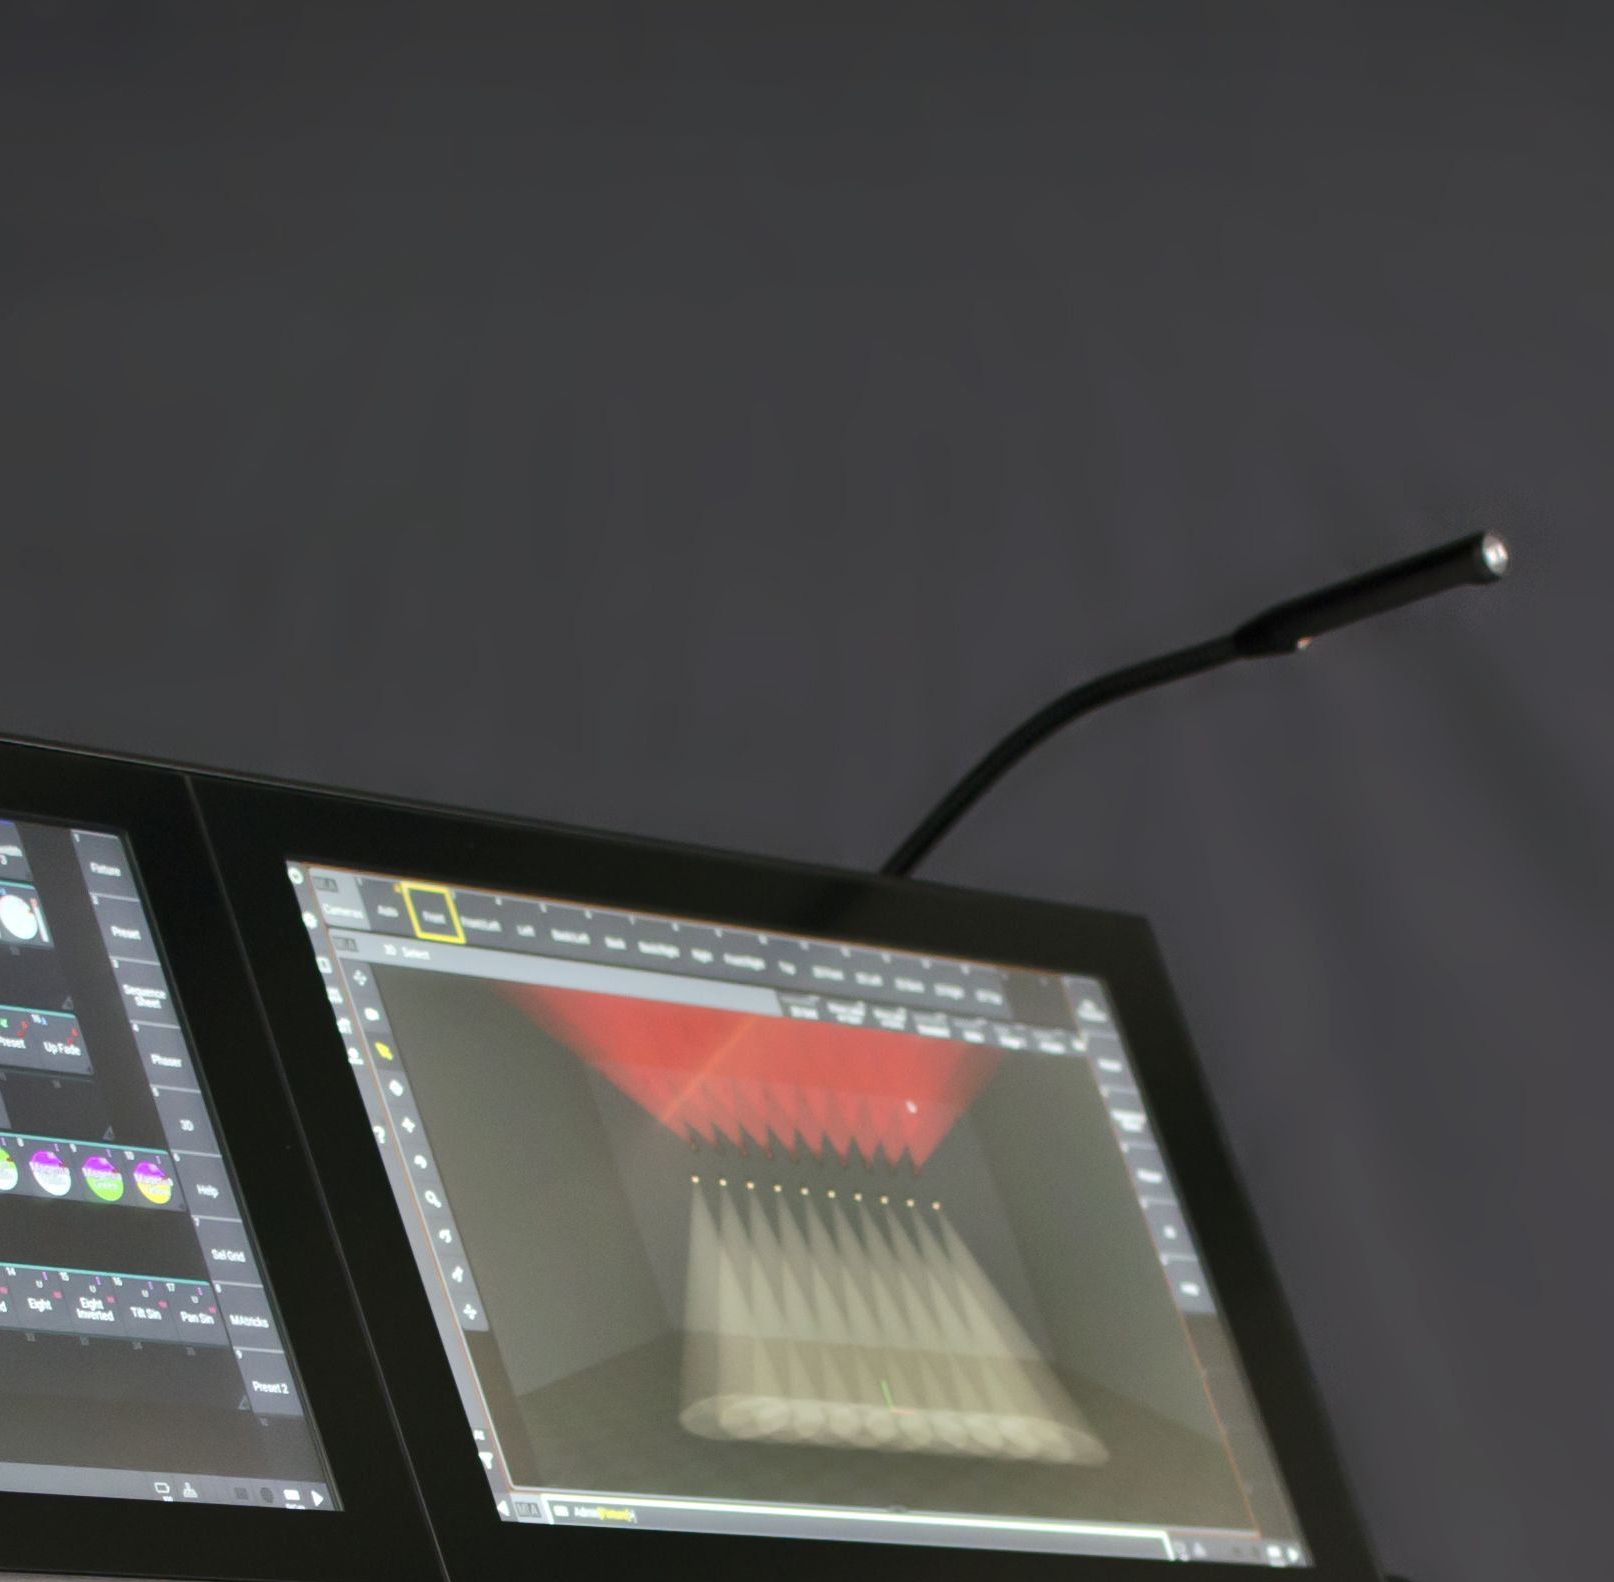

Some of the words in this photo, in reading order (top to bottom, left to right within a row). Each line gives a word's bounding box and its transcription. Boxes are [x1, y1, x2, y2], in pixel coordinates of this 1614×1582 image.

[27, 1297, 52, 1312] Eight
[79, 1297, 104, 1311] Eight
[77, 1308, 115, 1321] Inverted
[180, 1311, 198, 1324] Pan
